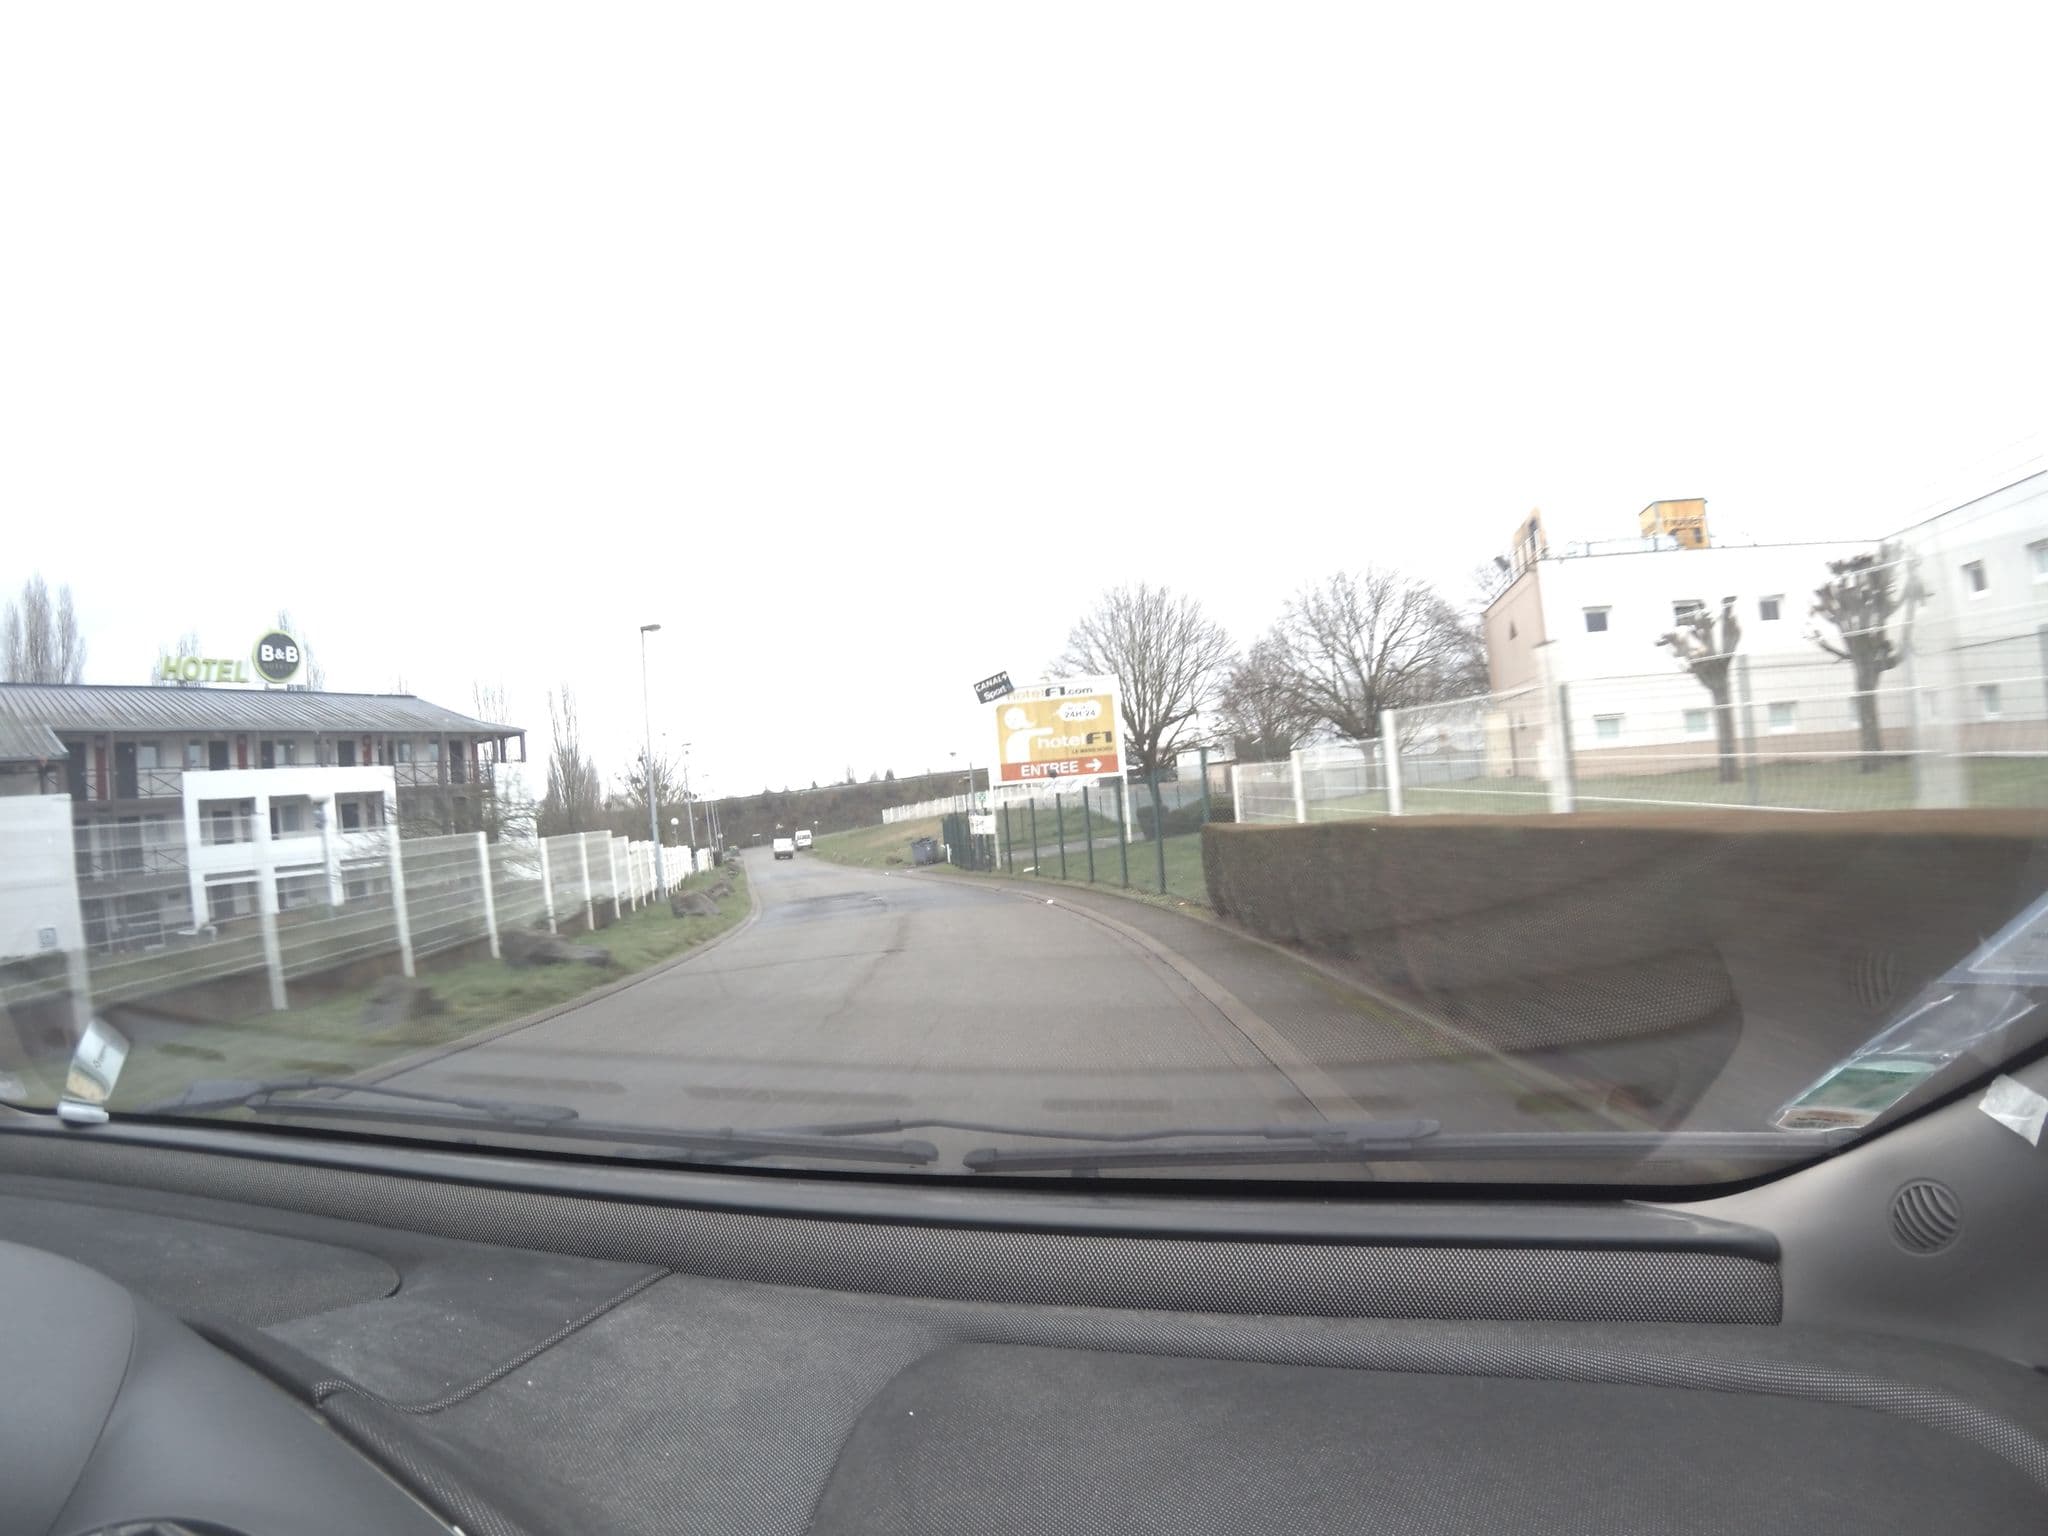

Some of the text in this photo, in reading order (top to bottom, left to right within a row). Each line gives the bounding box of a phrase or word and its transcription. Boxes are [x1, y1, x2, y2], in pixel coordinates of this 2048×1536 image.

[261, 644, 298, 663] B&B
[161, 655, 249, 683] HOTEL
[975, 672, 1008, 692] CANAL+
